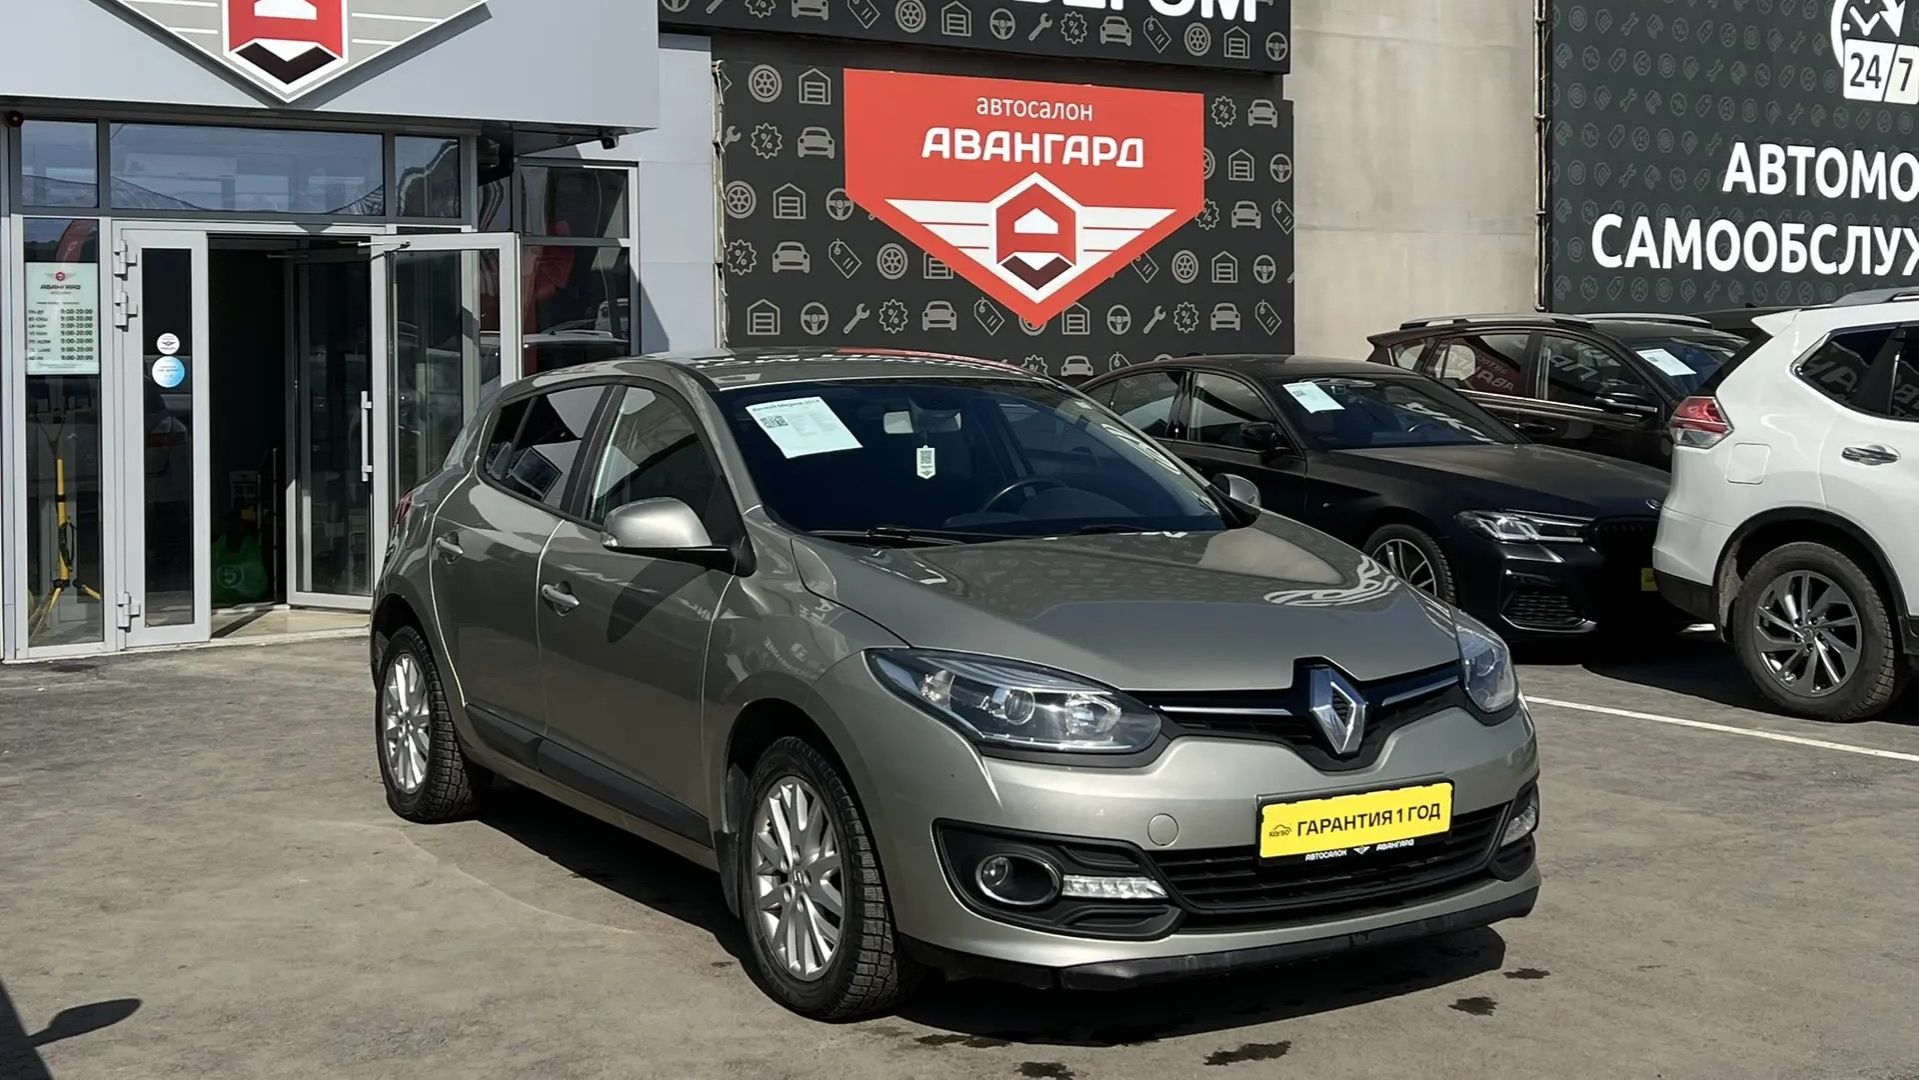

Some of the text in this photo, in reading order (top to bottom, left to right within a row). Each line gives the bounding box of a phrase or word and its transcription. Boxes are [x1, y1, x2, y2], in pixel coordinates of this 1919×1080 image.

[976, 96, 1093, 122] автосалон
[921, 126, 1144, 169] АВАНГАРД
[1297, 802, 1441, 837] ГАРАНТИЯ 1 ГОД
[1305, 838, 1415, 861] АВТОСАЛОН АВАНГАРД
